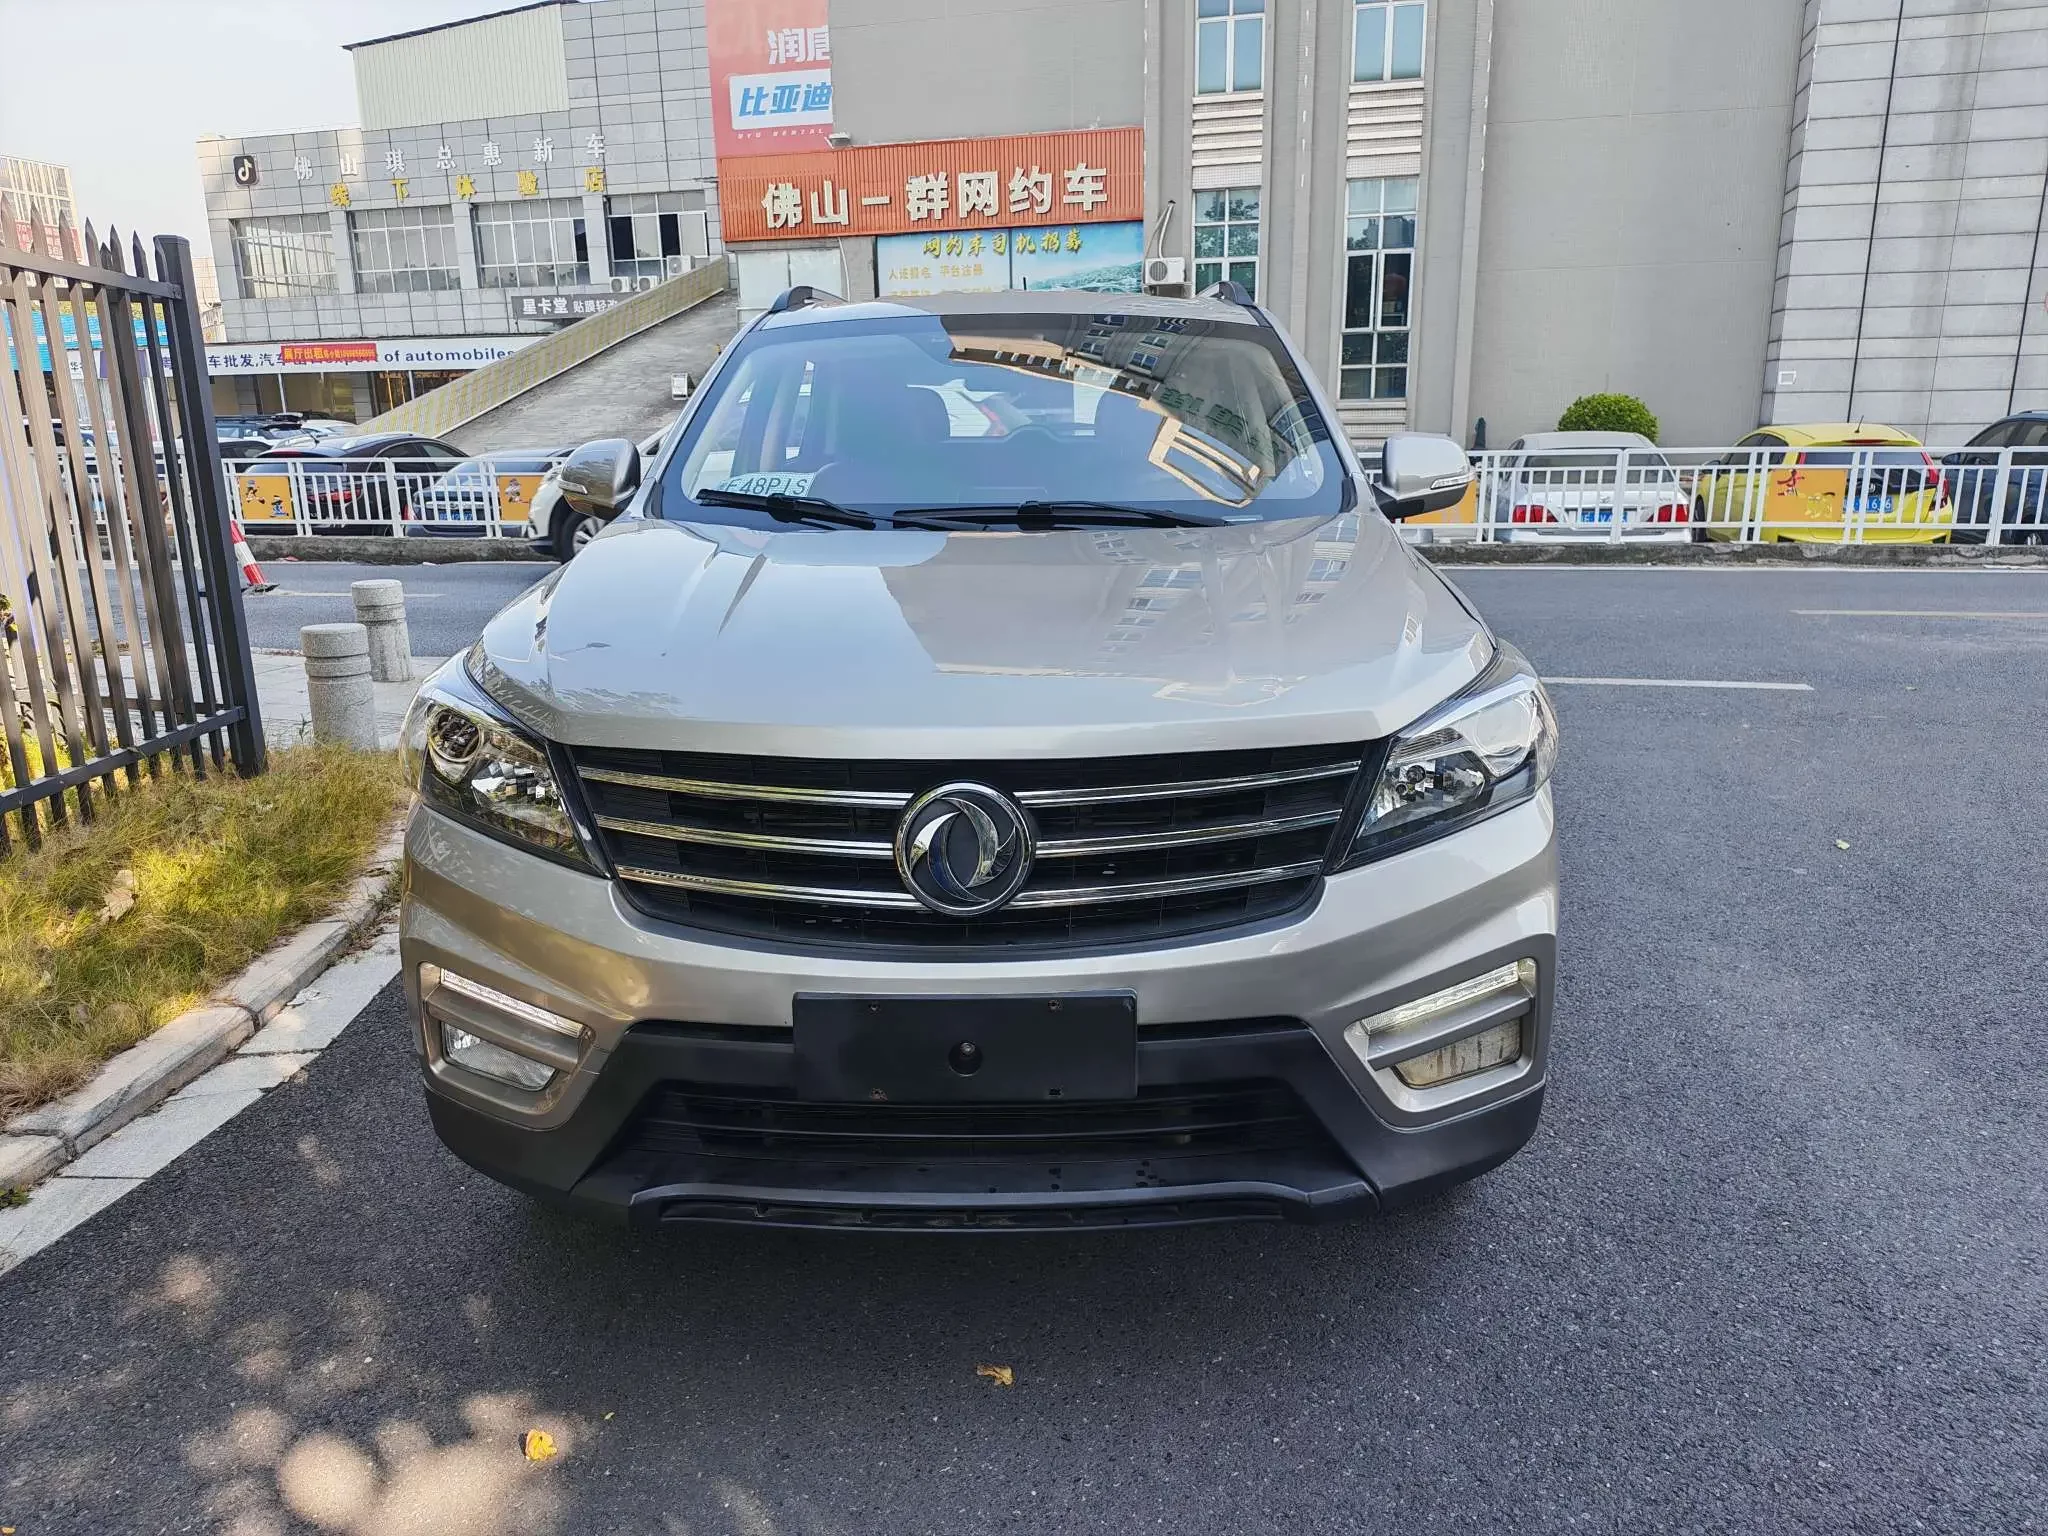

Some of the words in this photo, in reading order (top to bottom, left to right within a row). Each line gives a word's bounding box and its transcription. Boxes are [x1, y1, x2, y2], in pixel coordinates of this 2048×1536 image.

[738, 81, 832, 117] 比亚迪
[293, 133, 605, 181] 佛山琪总惠新车
[329, 166, 606, 208] 线下体验店
[761, 162, 1107, 229] 佛山一群网约车
[923, 228, 1083, 258] 网约车司机招募
[523, 297, 568, 314] 星卡堂
[384, 350, 399, 362] of
